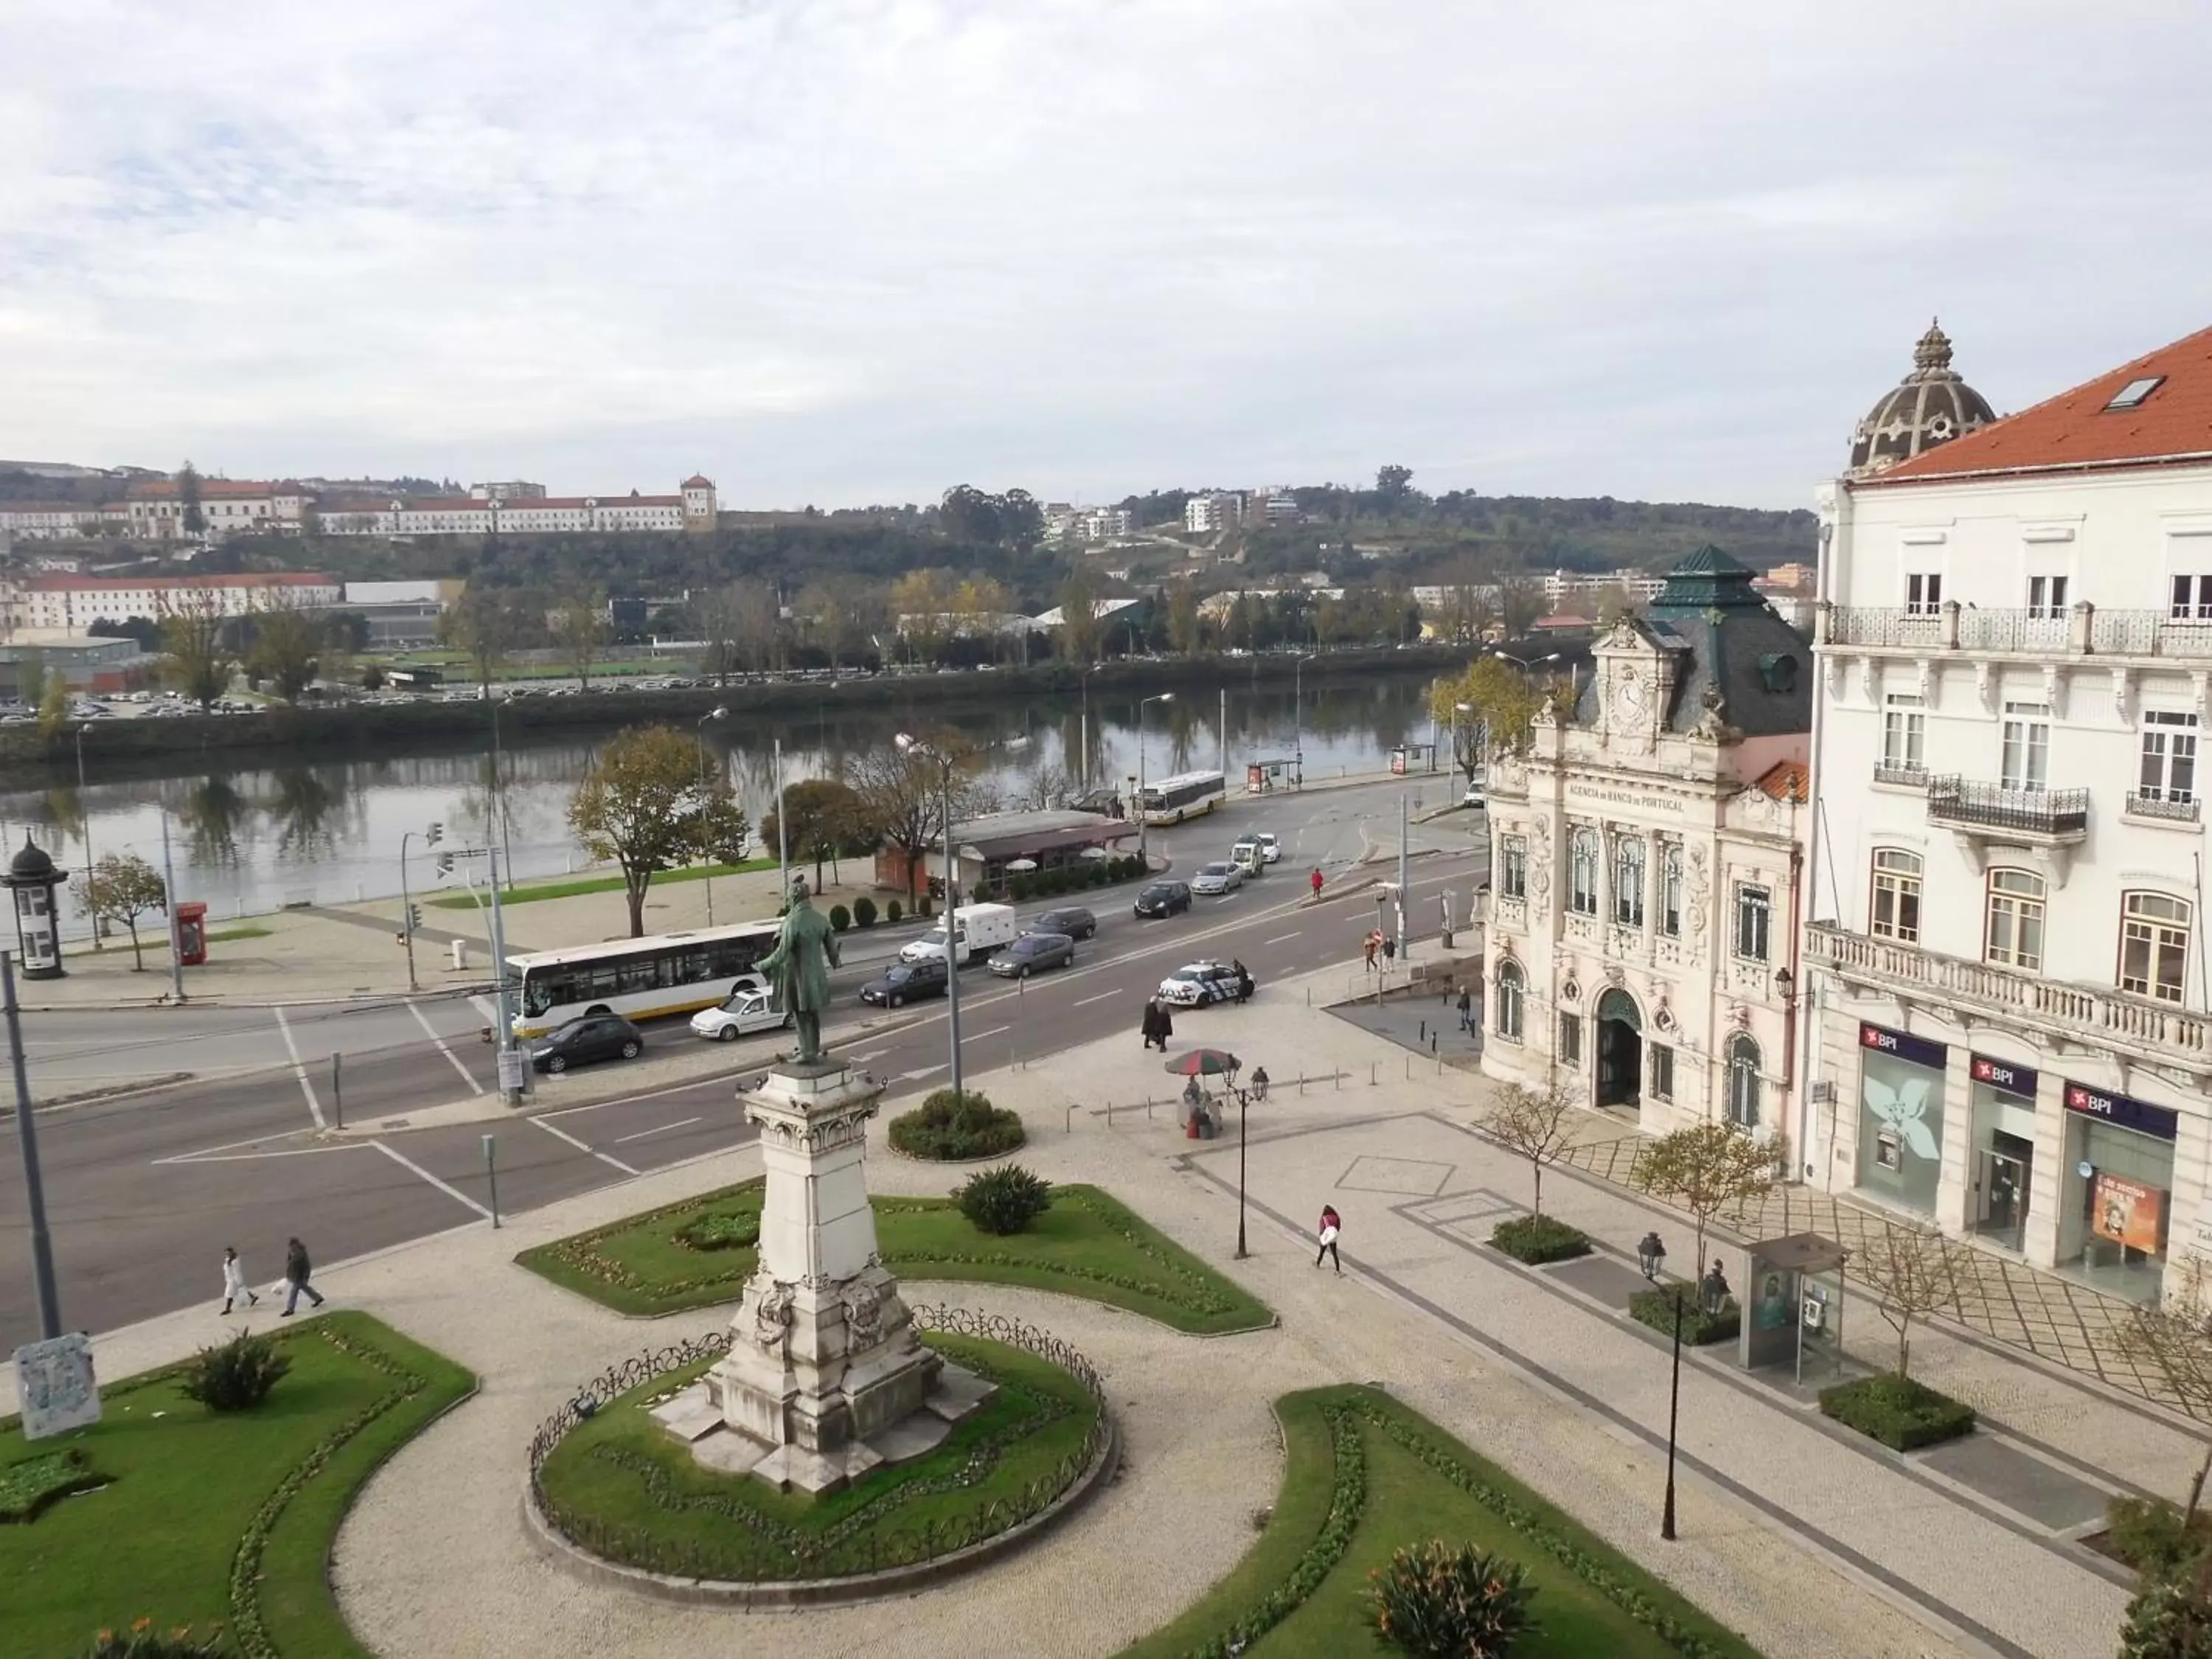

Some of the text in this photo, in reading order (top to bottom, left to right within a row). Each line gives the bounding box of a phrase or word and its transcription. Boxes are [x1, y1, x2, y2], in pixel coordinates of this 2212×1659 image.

[1607, 791, 1632, 804] BANCO
[1641, 796, 1685, 813] PORTUGAL
[1878, 1034, 1897, 1050] BPI
[1993, 1067, 2013, 1085] BPI
[2088, 1096, 2112, 1114] BPI
